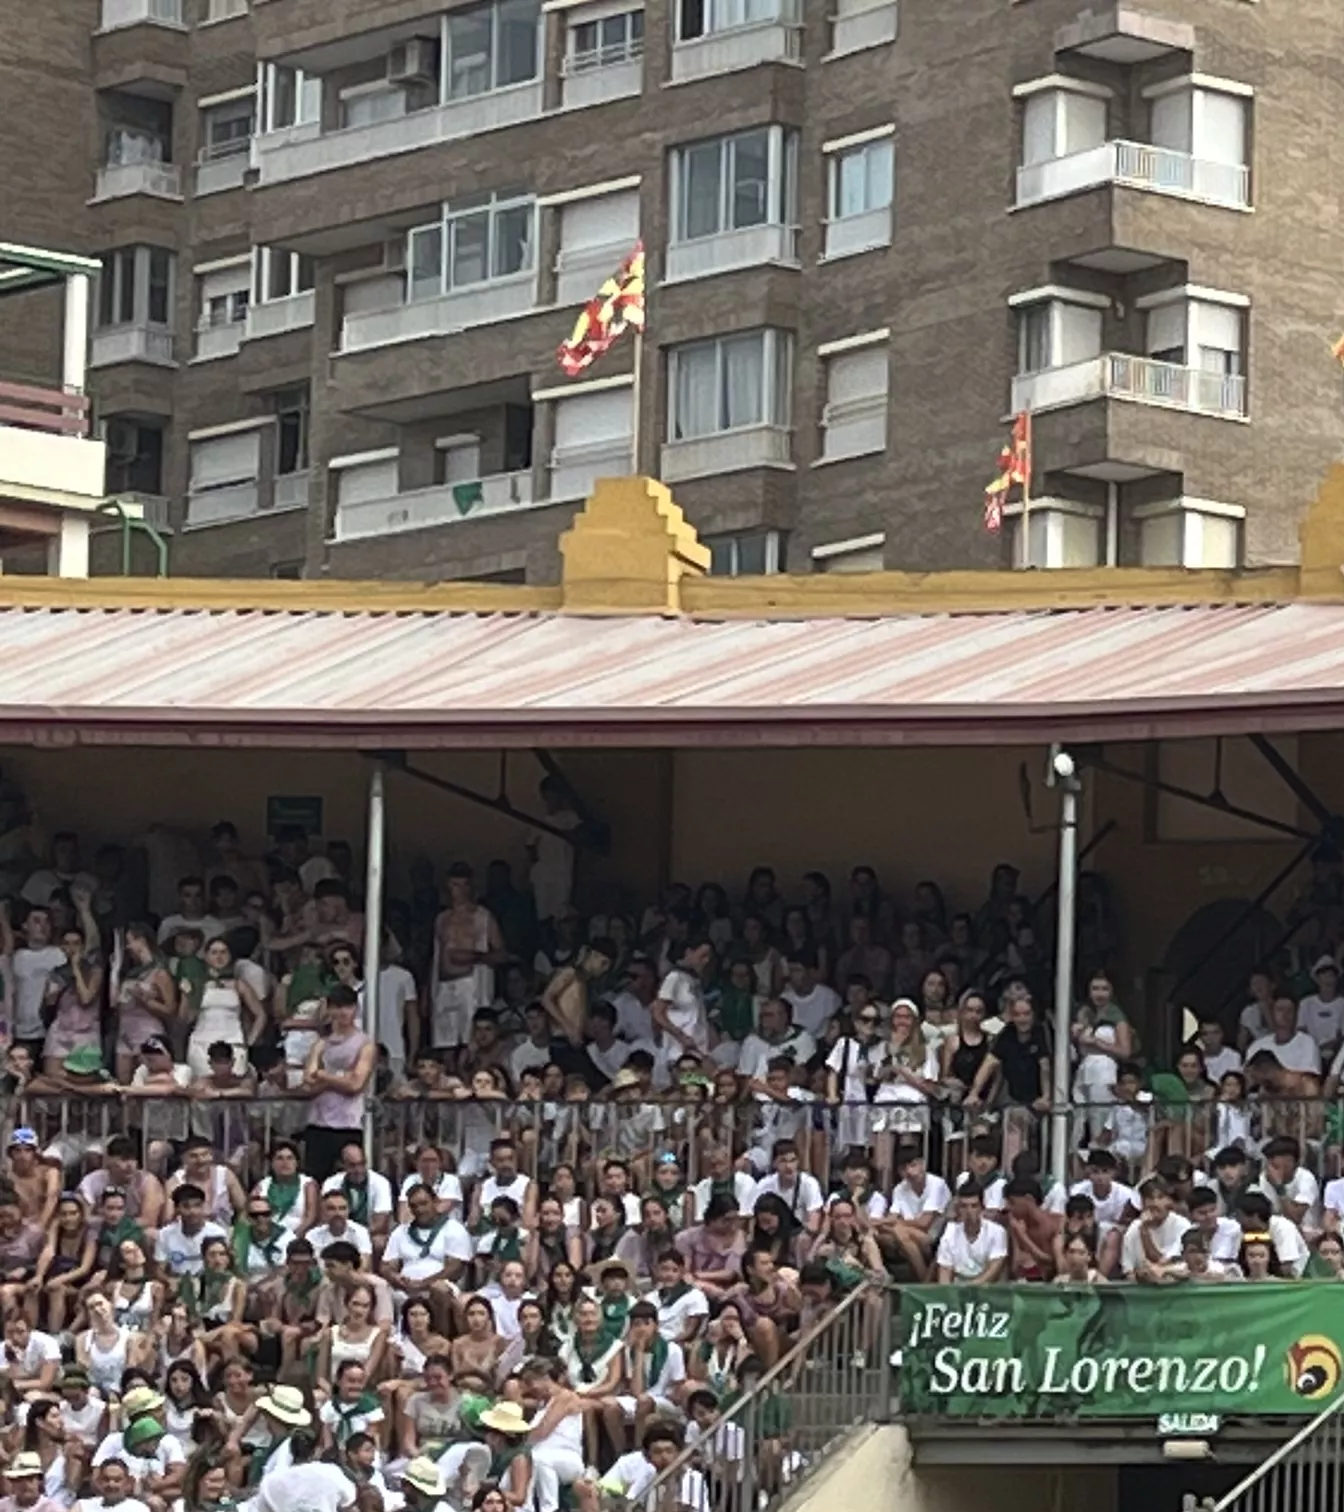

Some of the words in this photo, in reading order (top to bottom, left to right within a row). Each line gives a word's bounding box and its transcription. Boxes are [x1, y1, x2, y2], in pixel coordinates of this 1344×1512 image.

[908, 1301, 1010, 1348] ¡Feliz
[929, 1345, 1026, 1394] San
[1037, 1343, 1267, 1395] Lorenzo!
